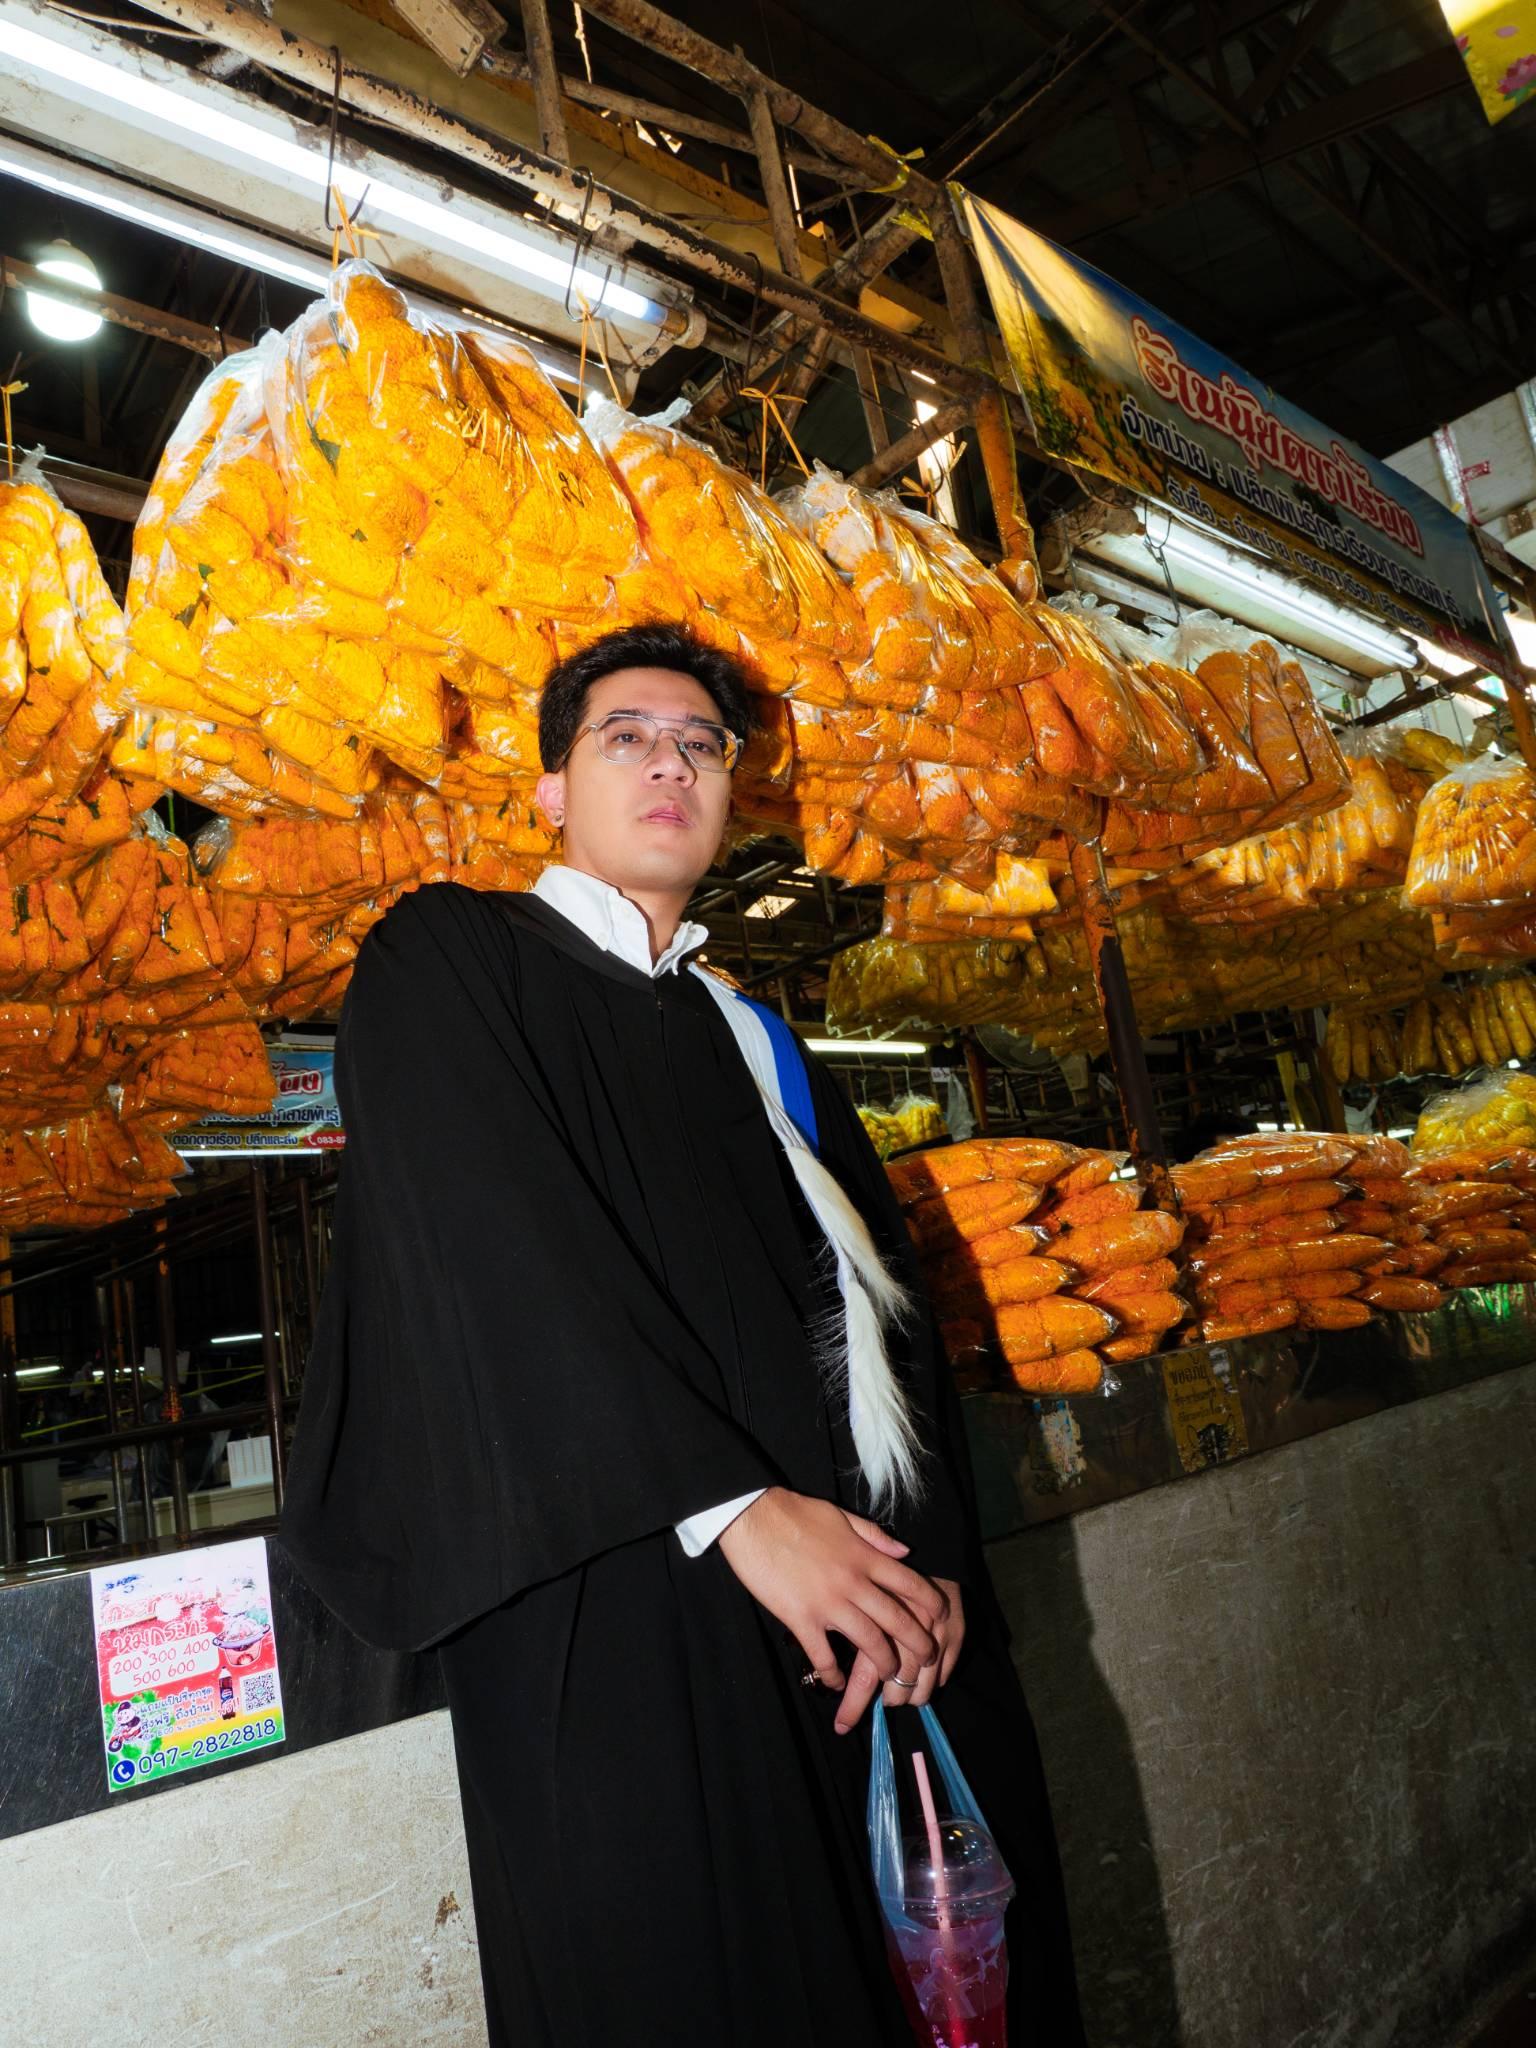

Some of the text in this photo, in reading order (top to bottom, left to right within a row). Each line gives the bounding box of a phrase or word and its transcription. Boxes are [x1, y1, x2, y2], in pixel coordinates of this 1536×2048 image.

[1121, 395, 1211, 479] จำหน่าย
[172, 1131, 241, 1147] ดอกดาวเรือง
[113, 1637, 211, 1676] 200 300 400
[133, 1658, 196, 1688] 500 600
[138, 1718, 276, 1774] 097-2822818
